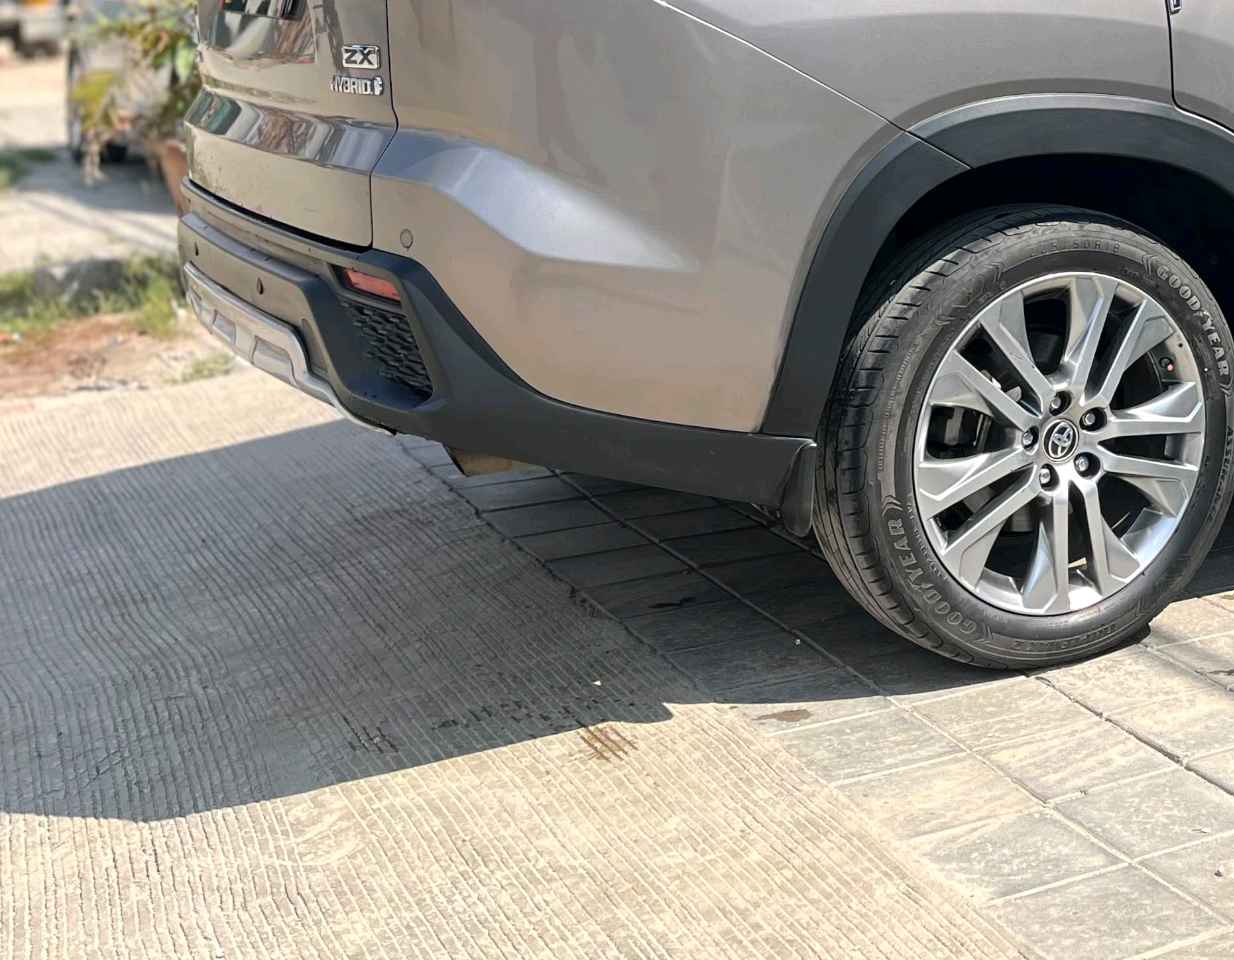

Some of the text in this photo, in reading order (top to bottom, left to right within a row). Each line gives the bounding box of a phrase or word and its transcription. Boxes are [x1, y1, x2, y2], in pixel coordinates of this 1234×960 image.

[331, 75, 372, 95] HYBRID
[345, 48, 377, 65] ZX
[1156, 265, 1230, 377] GOODYEAR
[887, 518, 977, 635] GOODYEAR
